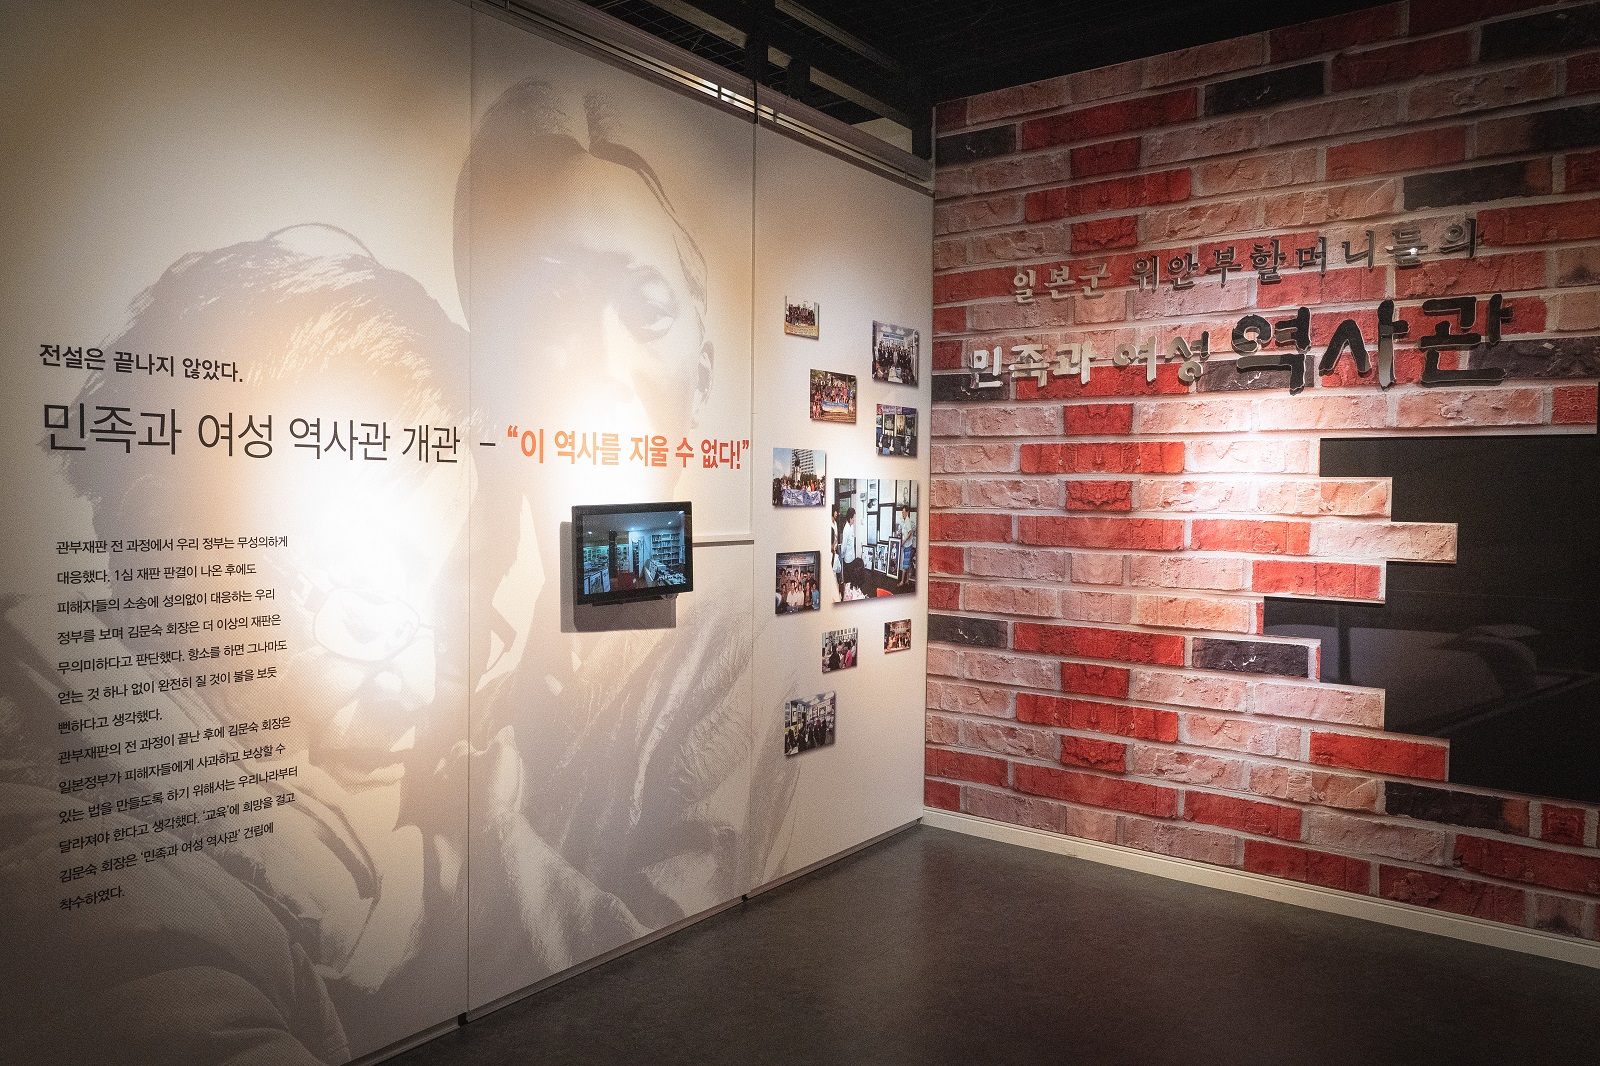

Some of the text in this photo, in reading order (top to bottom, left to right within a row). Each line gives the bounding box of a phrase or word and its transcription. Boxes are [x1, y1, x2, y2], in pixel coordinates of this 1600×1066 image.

[1012, 263, 1111, 305] 일본군
[39, 343, 243, 382] 전설은 끝나지 않았다.
[968, 293, 1514, 395] 민족과 여성 역사관
[43, 402, 182, 454] 민족과
[198, 412, 274, 459] 여성
[289, 415, 391, 461] 역사관
[402, 424, 461, 464] 개관
[508, 425, 544, 464] “이
[554, 431, 622, 466] 역사를
[629, 434, 669, 468] 지울
[675, 437, 694, 468] 수
[701, 439, 750, 470] 없다!”
[56, 535, 289, 555] 관부재판 전 과정에서 우리 정부는 무성의하게
[57, 563, 257, 584] 대응했다. 1심 재판 판결이 나온 후에도
[57, 589, 275, 615] 피해자들의 소송에 성의없이 대응하는 우리
[57, 614, 282, 645] 정부를 보며 김문숙 회장은 더 이상의 재판은
[57, 639, 288, 675] 무의미하다고 판단했다. 항소를 하면 그나마도
[58, 666, 278, 705] 얻는 것 하나 없이 완전히 질 것이 불을 보듯
[58, 708, 163, 735] 뻔하다고 생각했다.
[58, 716, 292, 764] 관부재판의 전 과정이 끝난 후에 김문숙 회장은
[58, 743, 286, 795] 일본정부가 피해자들에게 사과하고 보상할 수
[59, 766, 299, 824] 있는 법을 만들도록 하기 위해서는 우리나라부터
[59, 792, 296, 854] 달라져야 한다고 생각했다. ‘교육’에 희망을 걸고
[59, 822, 275, 883] 김문숙 회장은 ‘민족과 여성 역사관’ 건립에
[59, 885, 125, 912] 착수하였다.
